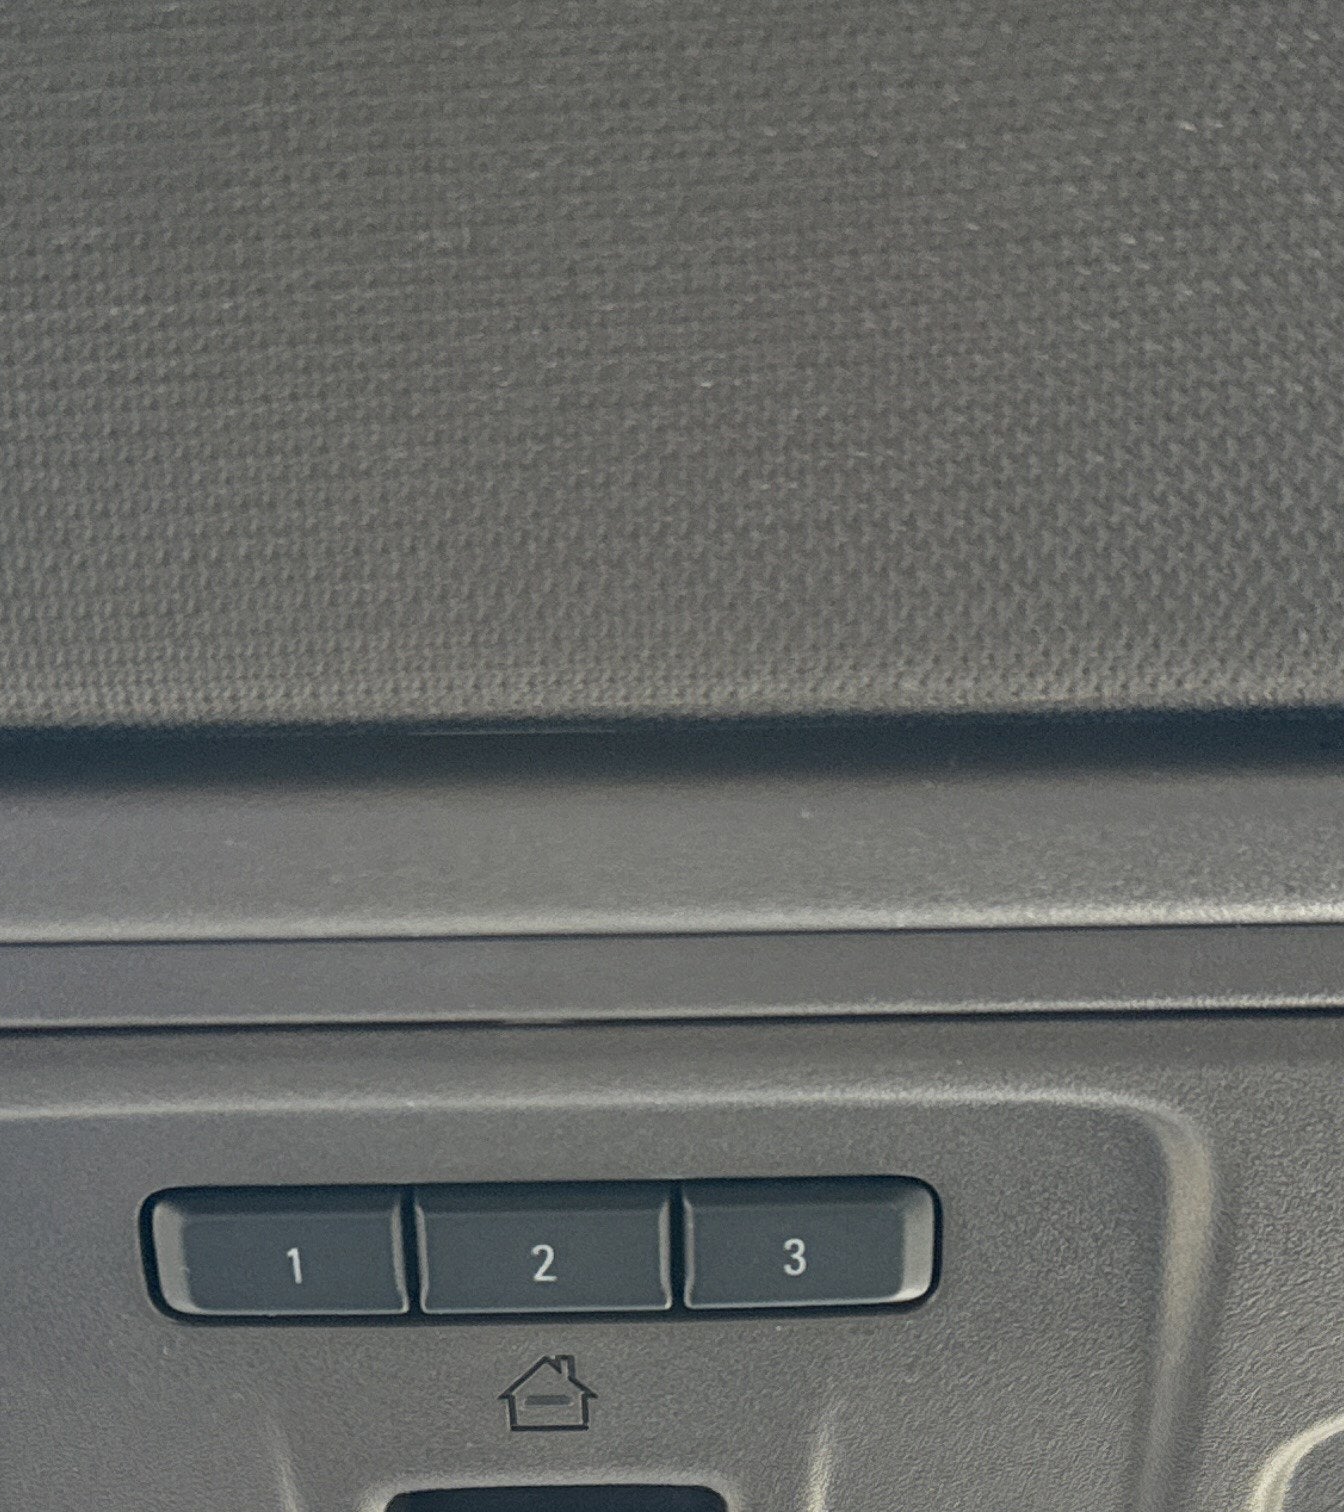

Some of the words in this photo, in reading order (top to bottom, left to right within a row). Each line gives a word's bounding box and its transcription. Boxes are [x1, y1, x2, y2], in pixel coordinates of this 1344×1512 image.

[286, 1248, 303, 1284] 1
[531, 1245, 556, 1281] 2
[782, 1239, 807, 1276] 3
